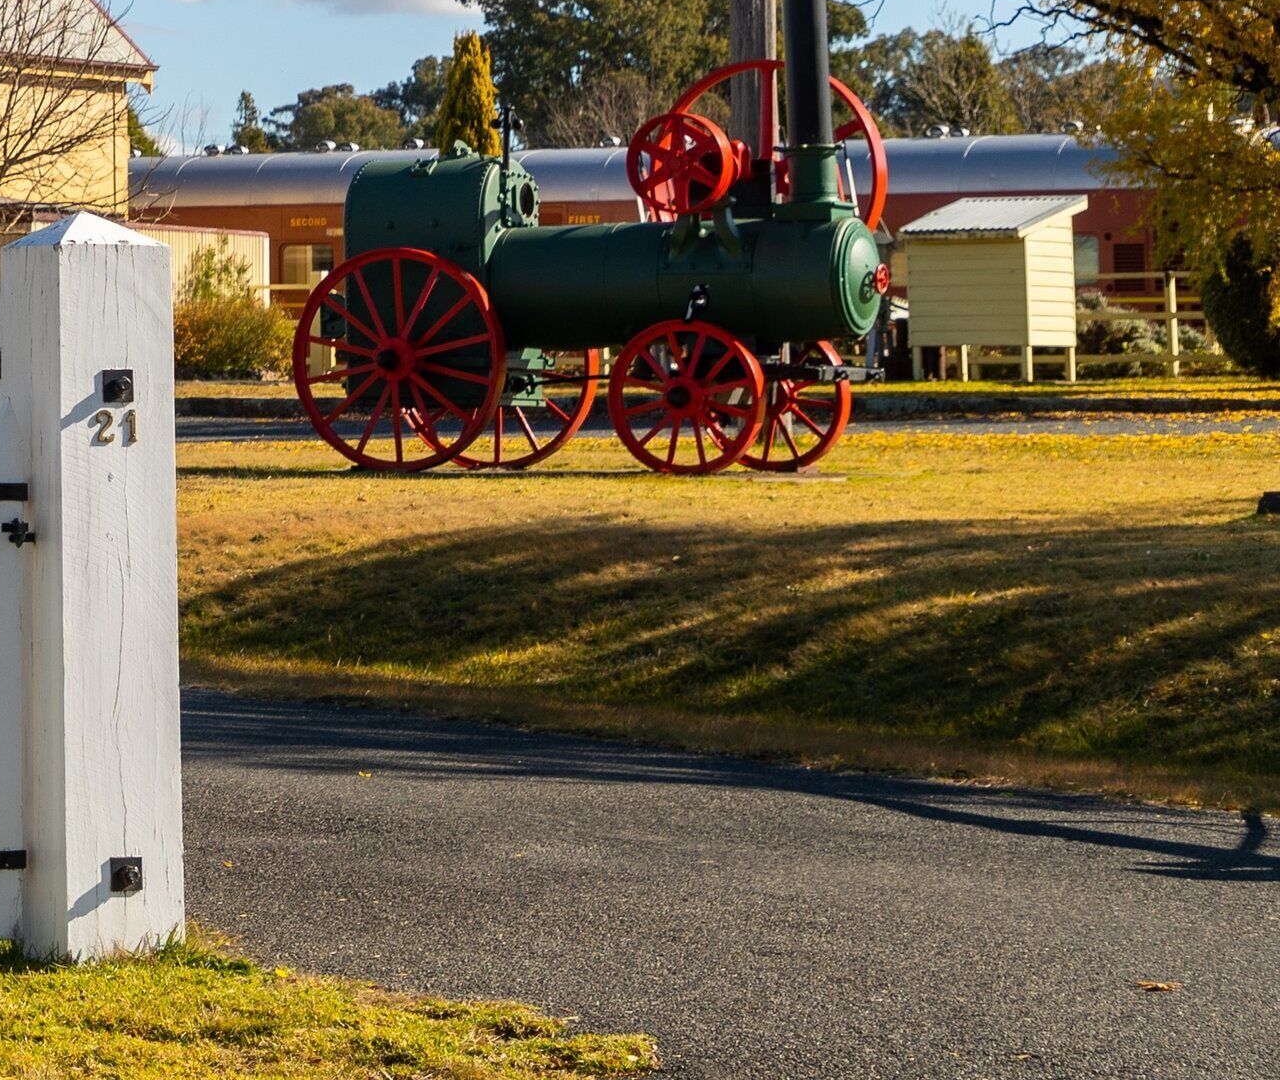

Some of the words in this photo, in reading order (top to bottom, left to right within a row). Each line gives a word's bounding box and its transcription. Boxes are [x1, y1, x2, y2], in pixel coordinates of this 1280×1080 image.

[290, 217, 327, 227] SECOND
[567, 215, 600, 224] FIRST
[95, 408, 138, 443] 21
